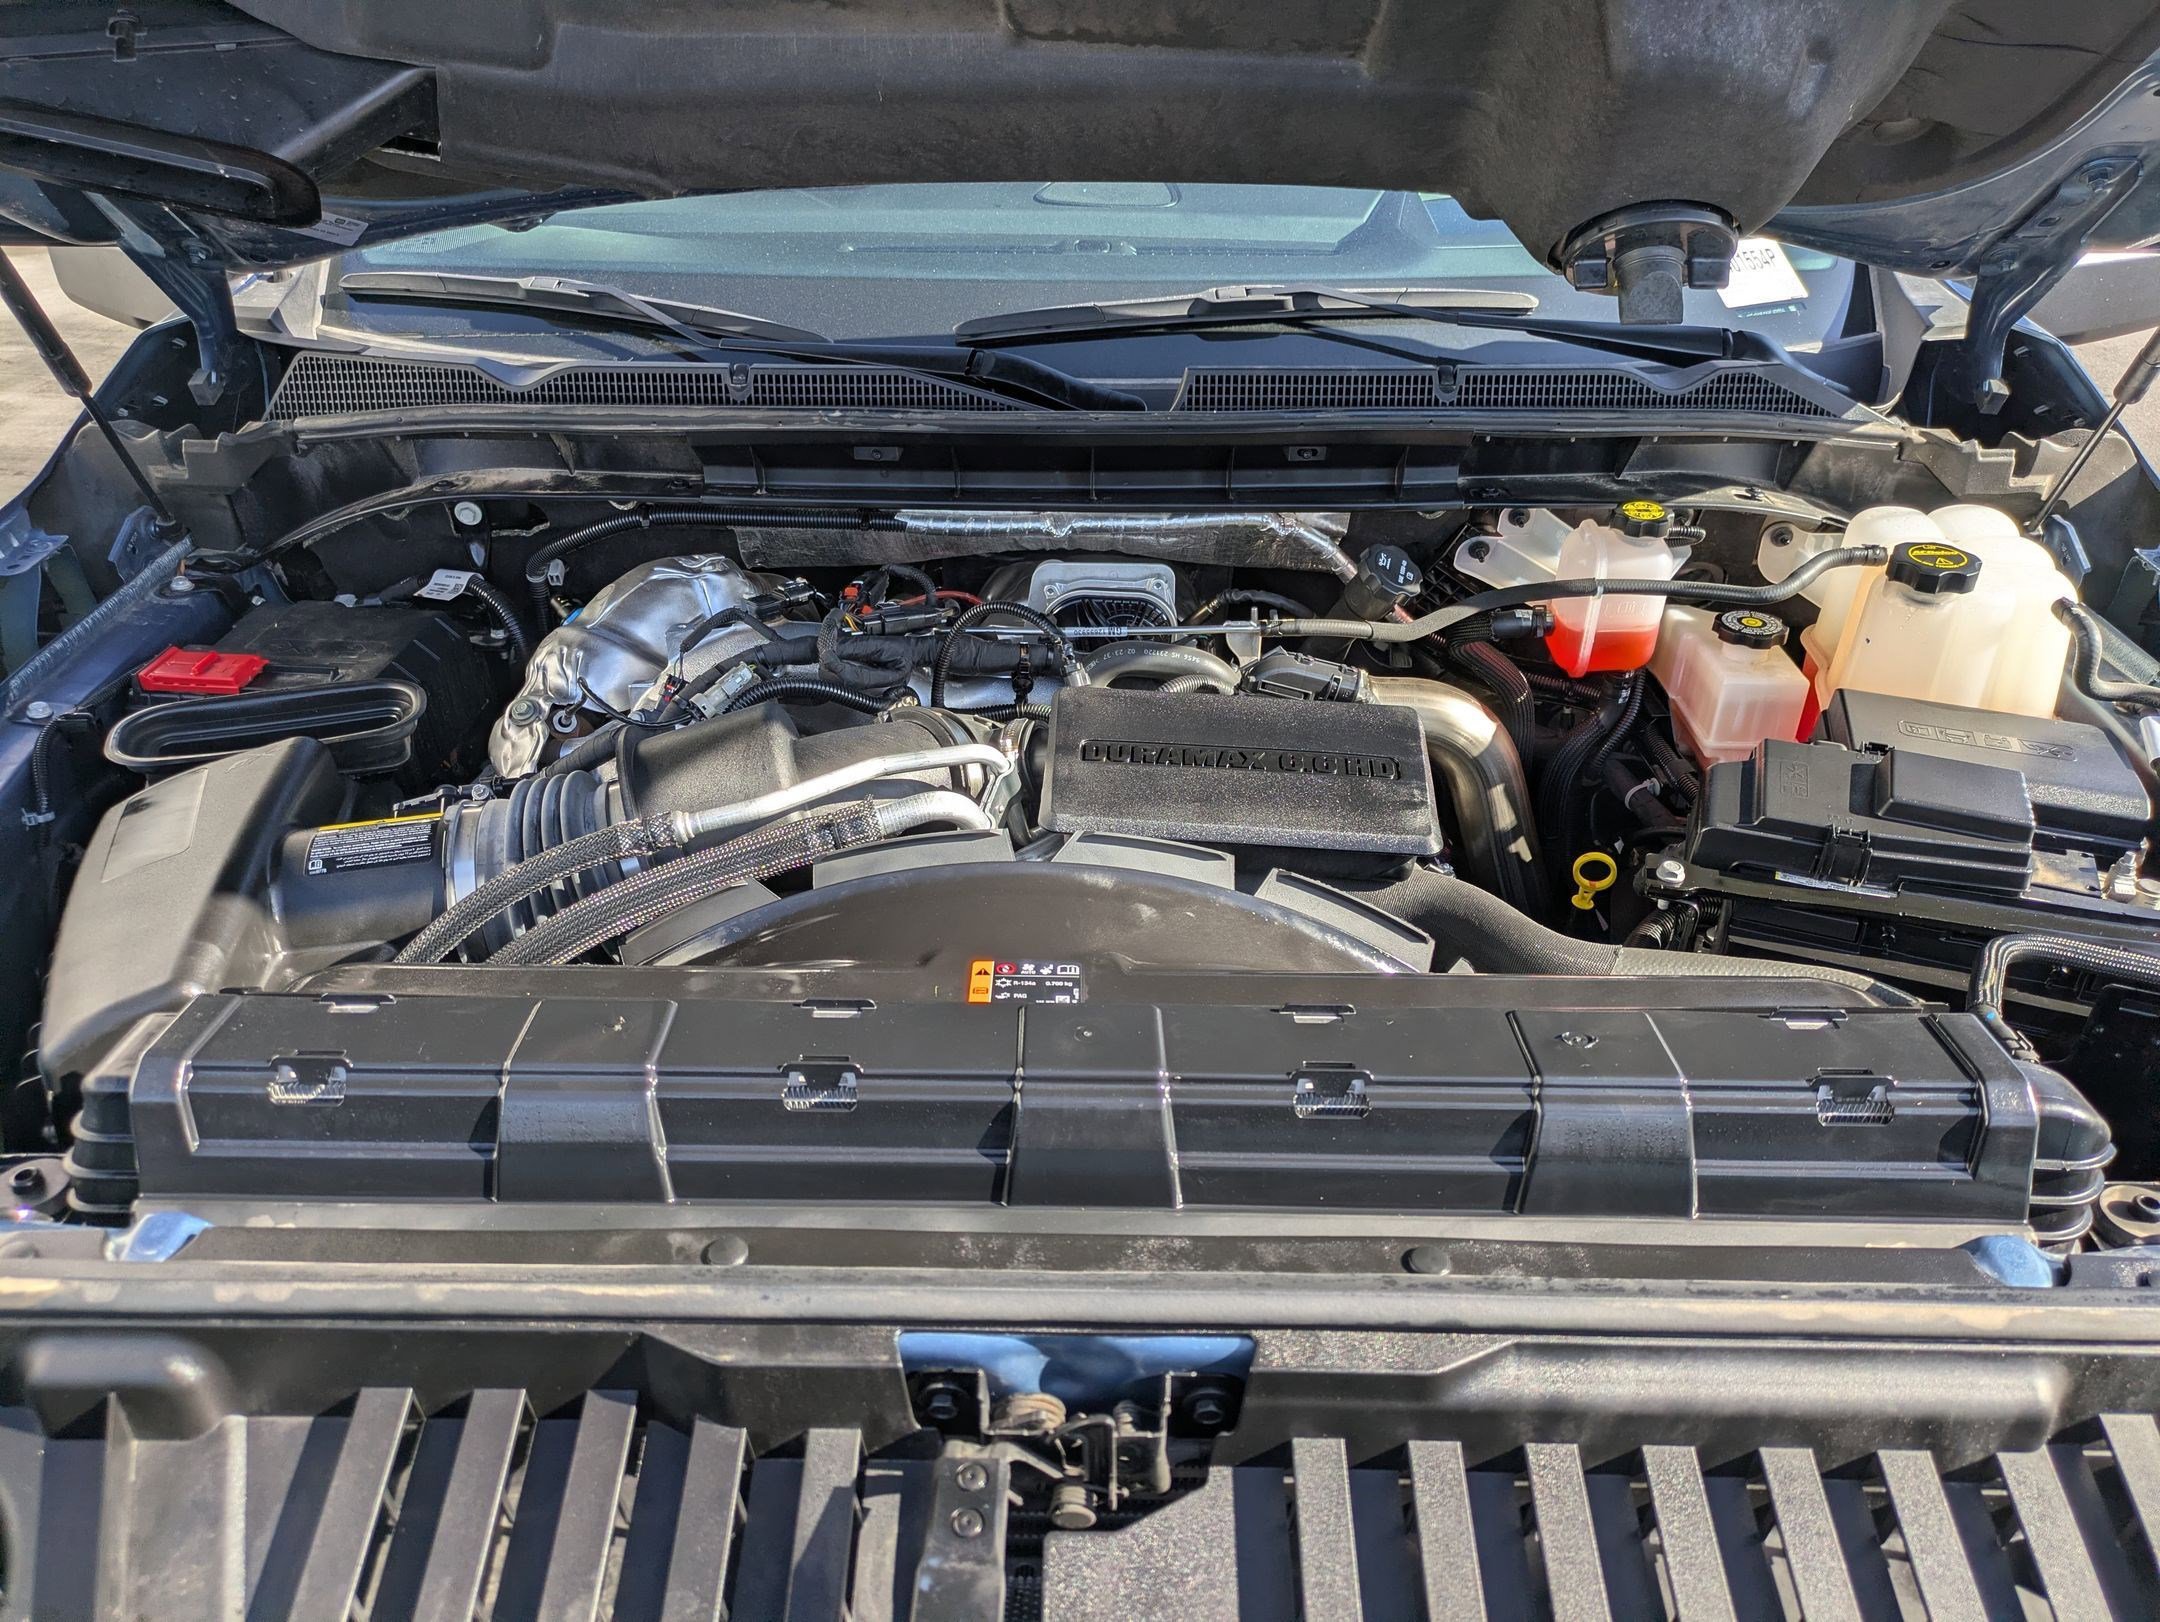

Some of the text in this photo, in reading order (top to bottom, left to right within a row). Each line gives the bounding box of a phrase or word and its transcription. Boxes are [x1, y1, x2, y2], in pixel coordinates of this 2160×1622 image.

[1108, 627, 1122, 636] GM
[1082, 744, 1267, 771] DURAMAX
[1344, 757, 1399, 780] HD
